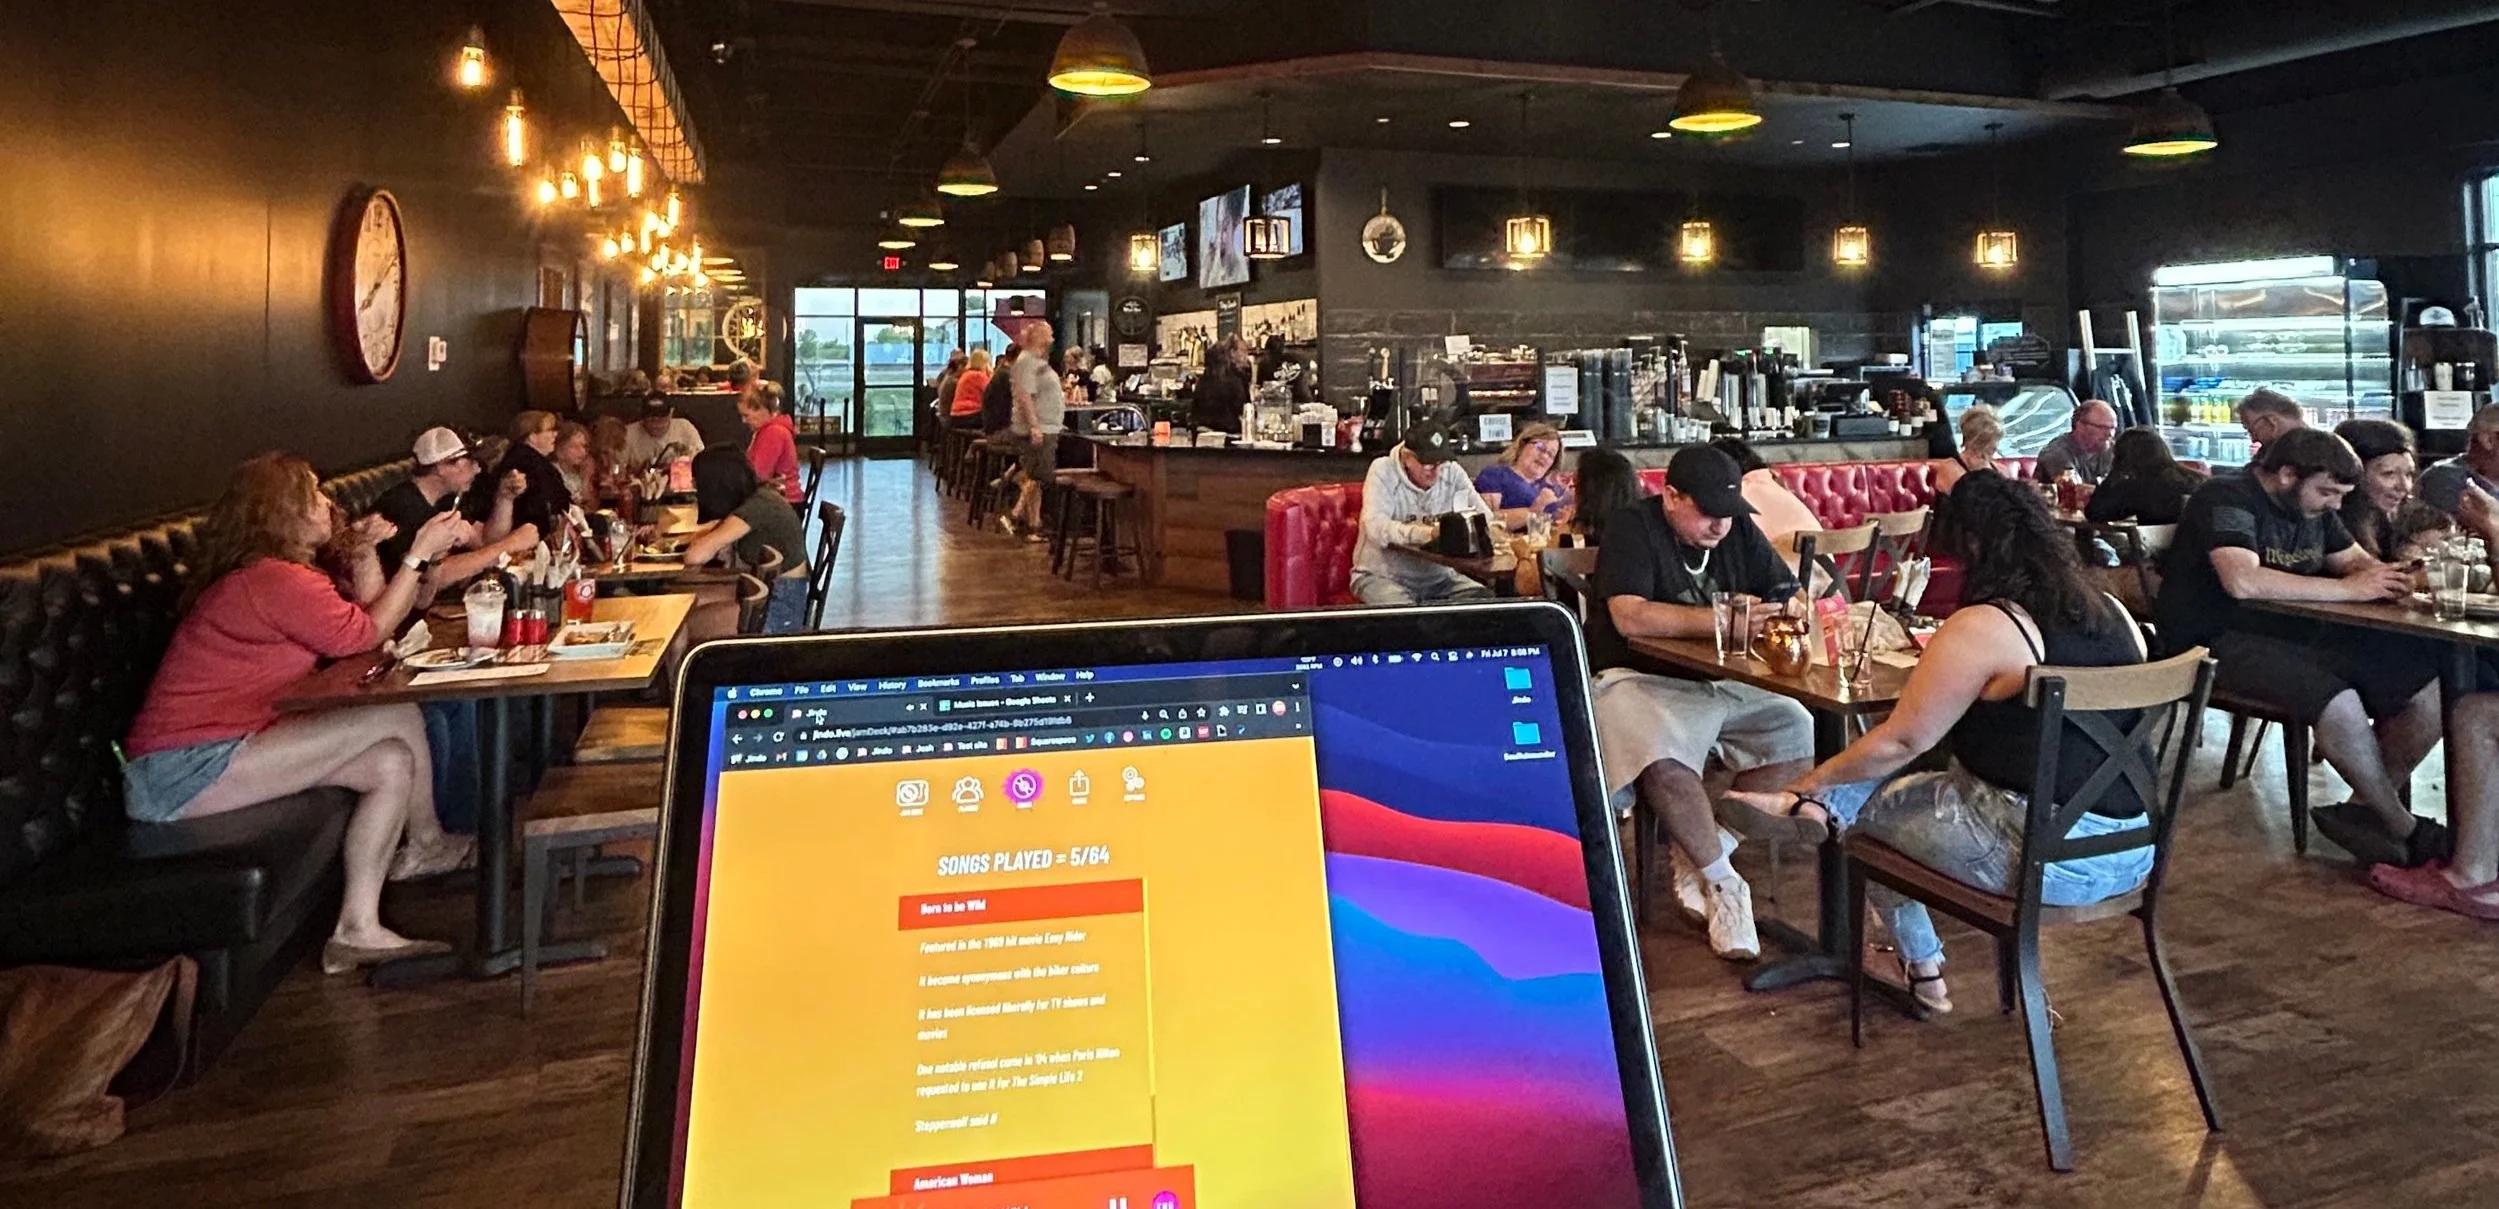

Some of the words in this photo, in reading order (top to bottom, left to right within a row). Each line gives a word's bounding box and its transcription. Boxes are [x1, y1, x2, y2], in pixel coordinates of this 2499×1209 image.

[1481, 649, 1491, 658] Fri
[750, 687, 783, 697] Chrome
[794, 686, 809, 695] File
[820, 684, 836, 694] Edit
[848, 682, 867, 692] View
[878, 680, 906, 692] History
[917, 678, 960, 689] Bookmarks
[970, 675, 1000, 686] Profiles
[1010, 673, 1025, 684] Tab
[1035, 671, 1066, 682] Window
[1075, 670, 1094, 681] Help
[937, 852, 990, 877] SONGS
[993, 847, 1053, 872] PLAYED
[1056, 852, 1068, 865] =
[1070, 843, 1112, 867] 5/64
[920, 902, 942, 916] Born
[942, 901, 953, 914] to
[954, 901, 966, 913] be
[966, 898, 986, 912] Wild
[919, 939, 957, 955] Featured
[956, 939, 966, 951] in
[967, 938, 982, 950] the
[1005, 934, 1017, 948] hit
[1018, 933, 1043, 946] movie
[1043, 932, 1064, 946] Easy
[1064, 929, 1087, 943] Rider
[927, 974, 961, 987] became
[961, 970, 1013, 986] synonymous
[1013, 968, 1032, 980] with
[1033, 966, 1048, 978] the
[1048, 964, 1069, 977] biker
[1070, 962, 1100, 975] culture
[927, 1007, 943, 1020] has
[943, 1005, 965, 1019] been
[965, 1002, 1001, 1017] licensed
[1001, 999, 1036, 1014] liberally
[1035, 998, 1050, 1011] for
[1051, 997, 1062, 1010] TV
[1062, 995, 1089, 1009] shows
[1089, 993, 1107, 1006] and
[916, 1027, 948, 1041] movies
[916, 1063, 934, 1076] One
[934, 1060, 967, 1075] notable
[967, 1057, 999, 1072] refusal
[999, 1055, 1023, 1069] came
[1024, 1054, 1034, 1066] in
[1049, 1050, 1072, 1064] when
[1072, 1048, 1095, 1062] Paris
[1095, 1046, 1121, 1060] Hilton
[915, 1081, 960, 1099] requested
[960, 1079, 971, 1093] to
[971, 1079, 988, 1092] use
[988, 1077, 996, 1090] it
[996, 1076, 1012, 1090] for
[1012, 1074, 1028, 1088] The
[1028, 1072, 1059, 1087] Simple
[1059, 1070, 1076, 1083] Life
[1075, 1069, 1084, 1082] 2
[914, 1115, 969, 1134] Steppenwolf
[968, 1112, 989, 1128] said
[912, 1174, 959, 1191] American
[959, 1172, 994, 1187] Woman
